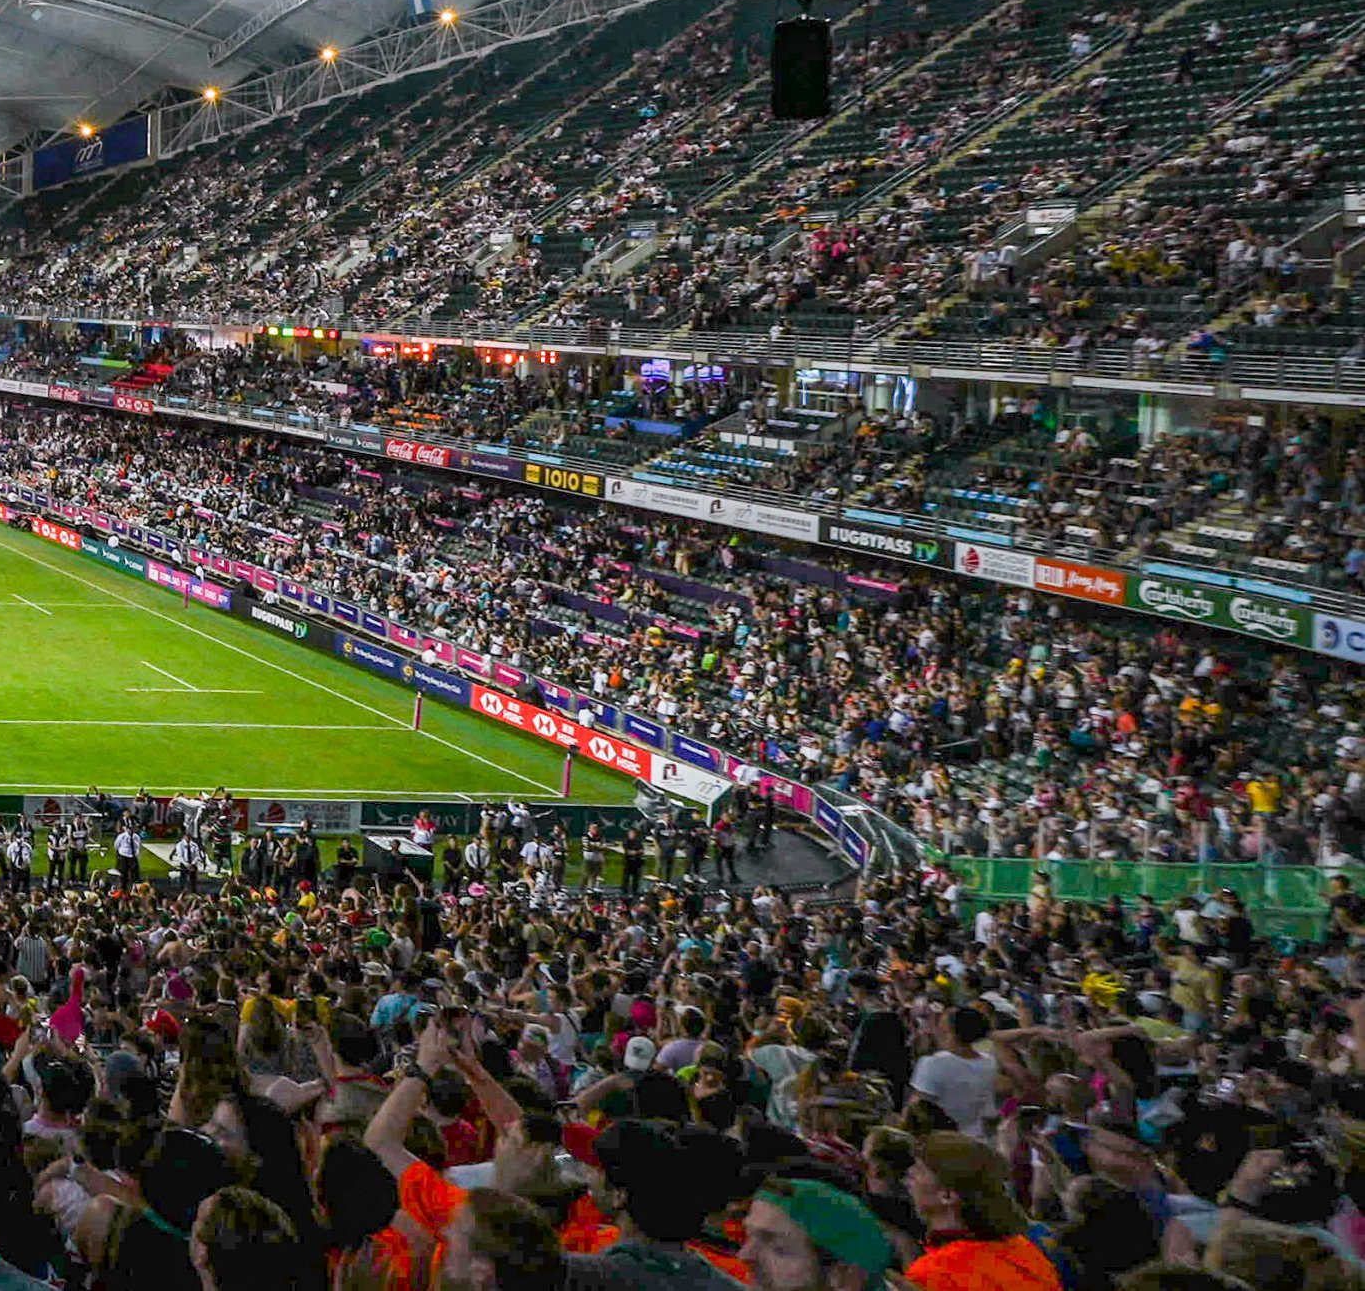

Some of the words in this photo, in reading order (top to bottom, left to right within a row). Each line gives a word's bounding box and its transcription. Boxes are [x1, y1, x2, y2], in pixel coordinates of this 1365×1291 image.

[545, 468, 580, 491] 1010
[829, 526, 913, 555] RUGBYPASS
[914, 539, 941, 562] TV
[1138, 579, 1215, 619] Carlsberg
[252, 607, 294, 633] RUGBYPASS
[1229, 596, 1298, 638] Carlsberg
[503, 710, 524, 726] HSBC
[556, 730, 579, 746] HSBC
[616, 756, 642, 775] HSBC
